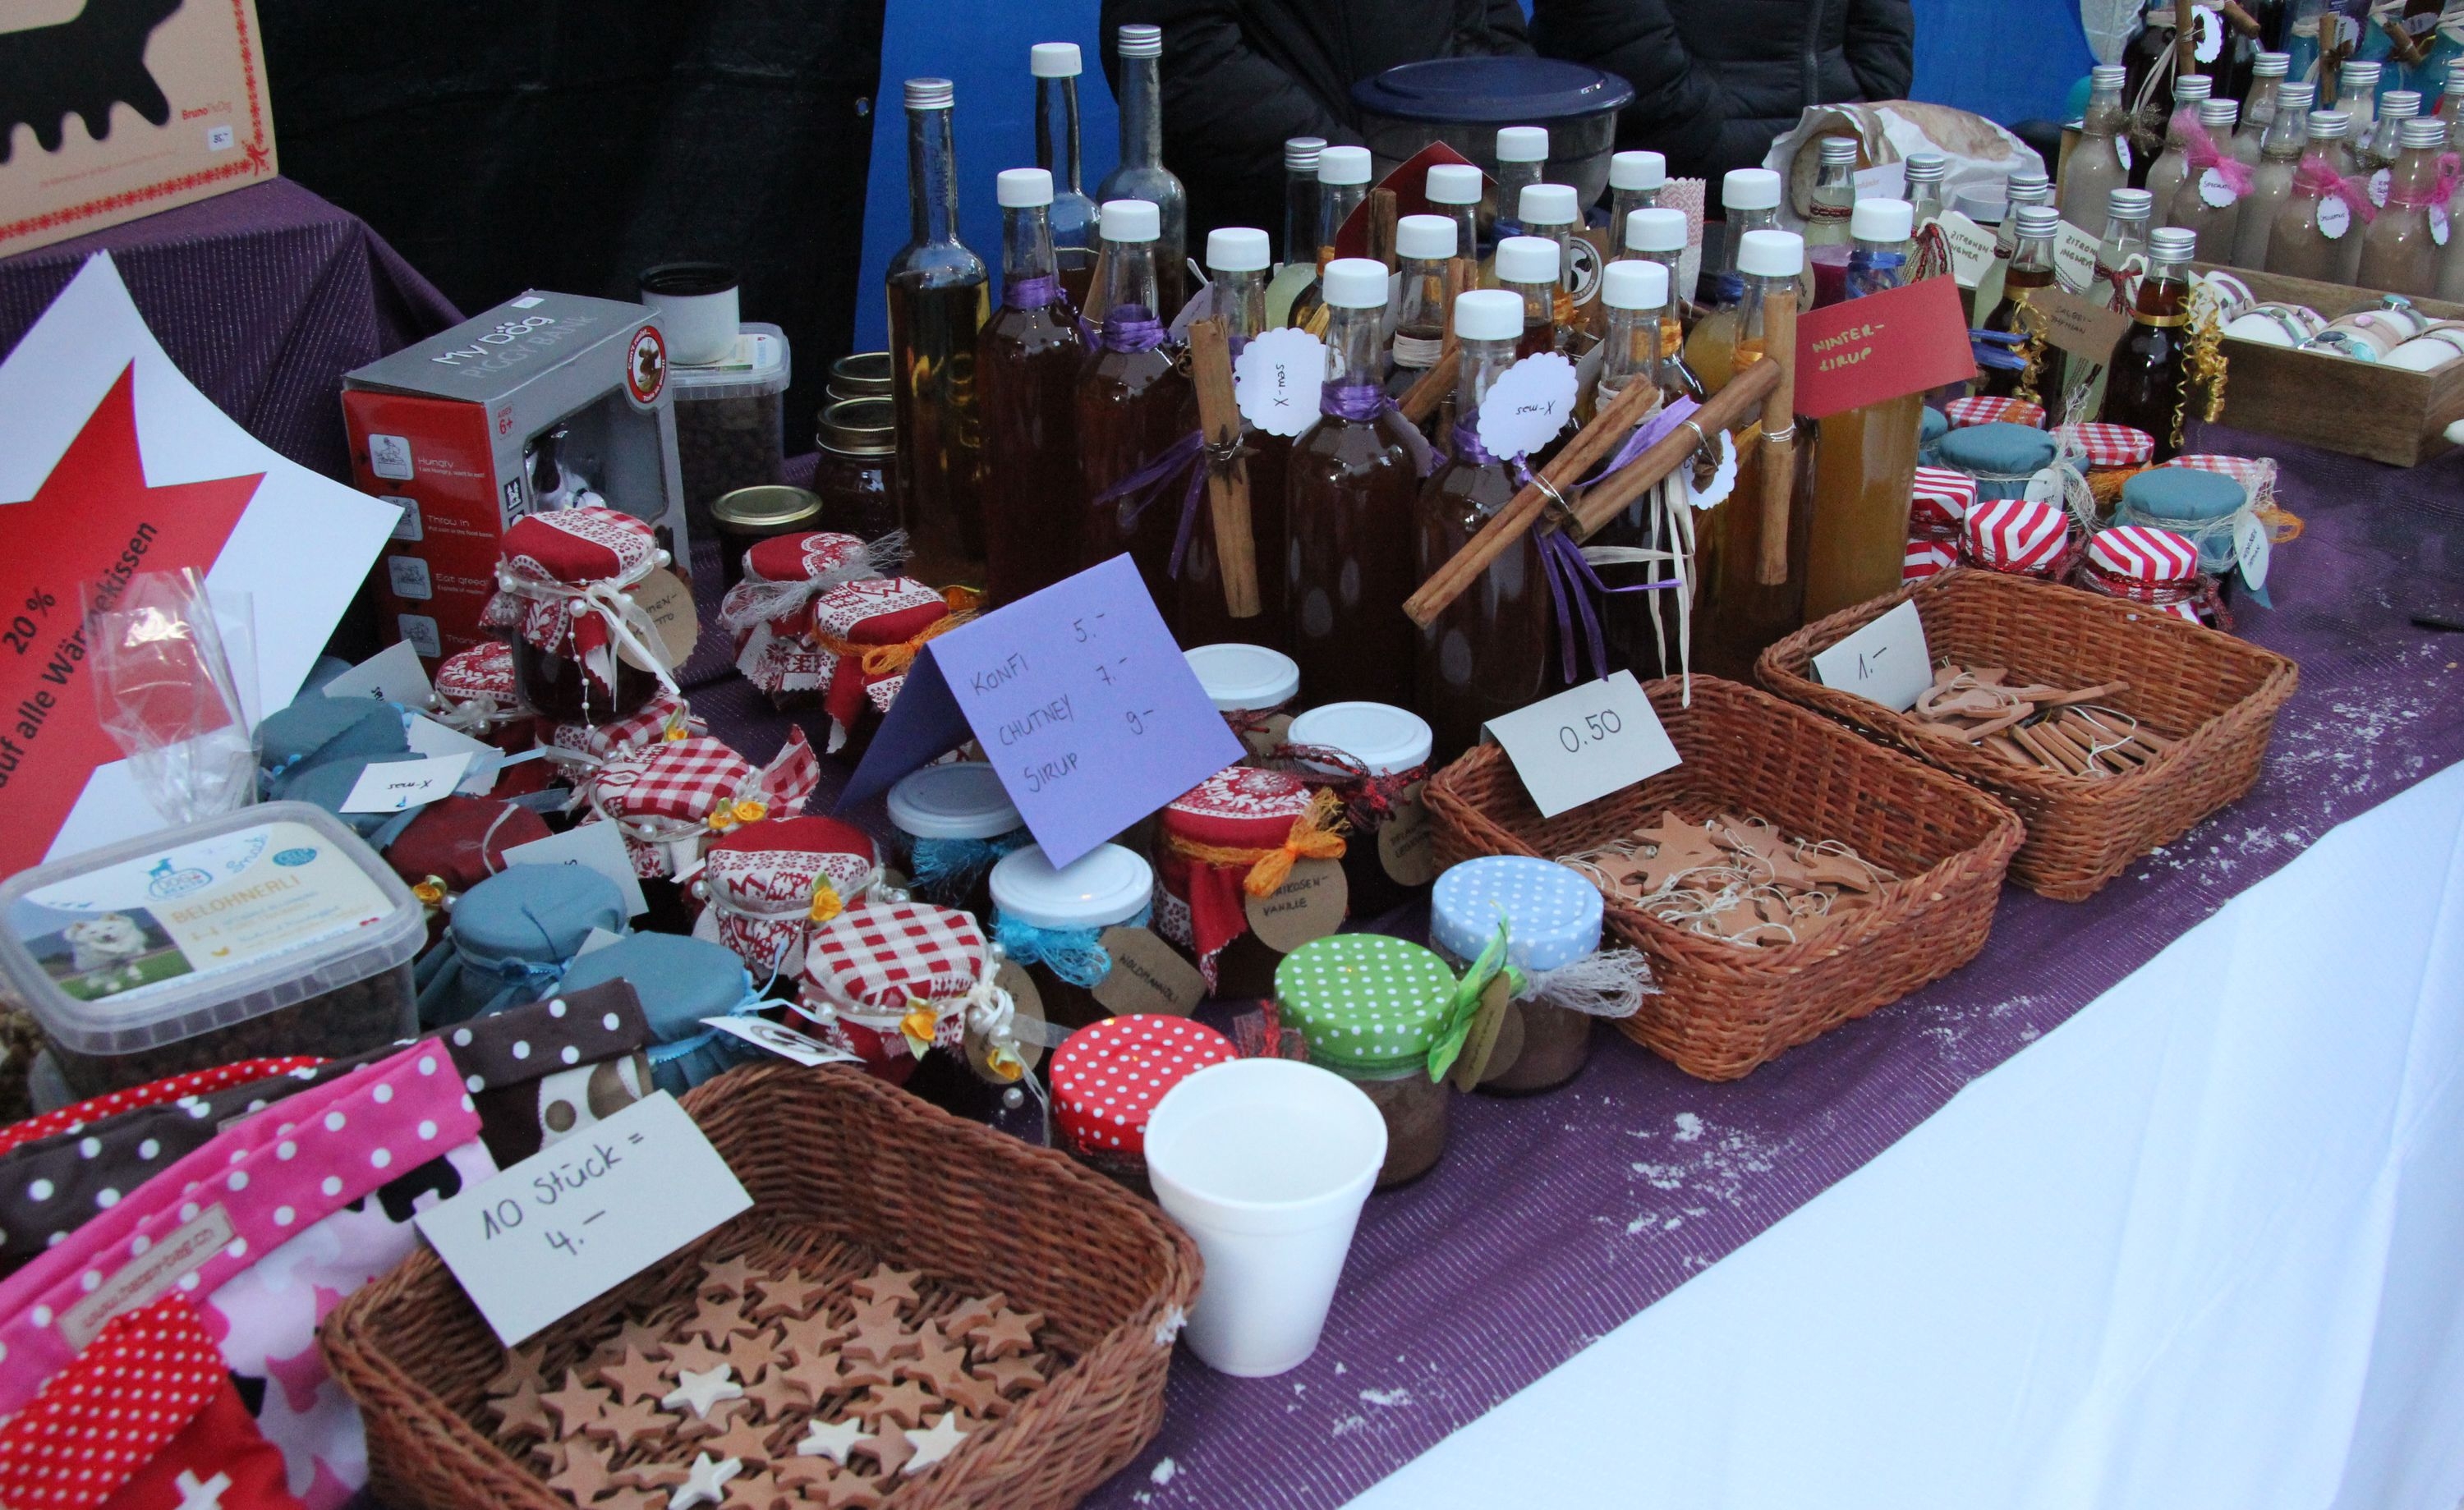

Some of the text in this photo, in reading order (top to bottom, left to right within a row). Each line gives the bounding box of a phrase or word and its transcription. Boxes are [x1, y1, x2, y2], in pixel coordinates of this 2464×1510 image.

[1950, 246, 1979, 262] NGWER
[2060, 249, 2094, 269] INGWER
[2065, 235, 2099, 256] ZITRON
[1813, 324, 1885, 353] WINTER-
[1819, 347, 1872, 371] SIRUP
[1272, 363, 1289, 406] X-mas
[499, 419, 513, 434] 6+
[1515, 399, 1556, 415] X-mas
[2, 586, 57, 656] 20 %
[970, 652, 1028, 696] KONFI
[16, 690, 57, 740] alle
[999, 693, 1075, 746] CHUTNEY
[1560, 709, 1621, 753] 0.50
[1024, 751, 1078, 794] SIRUP
[171, 874, 301, 923] BELOHNERLI
[482, 1132, 645, 1241] 10 Stück =
